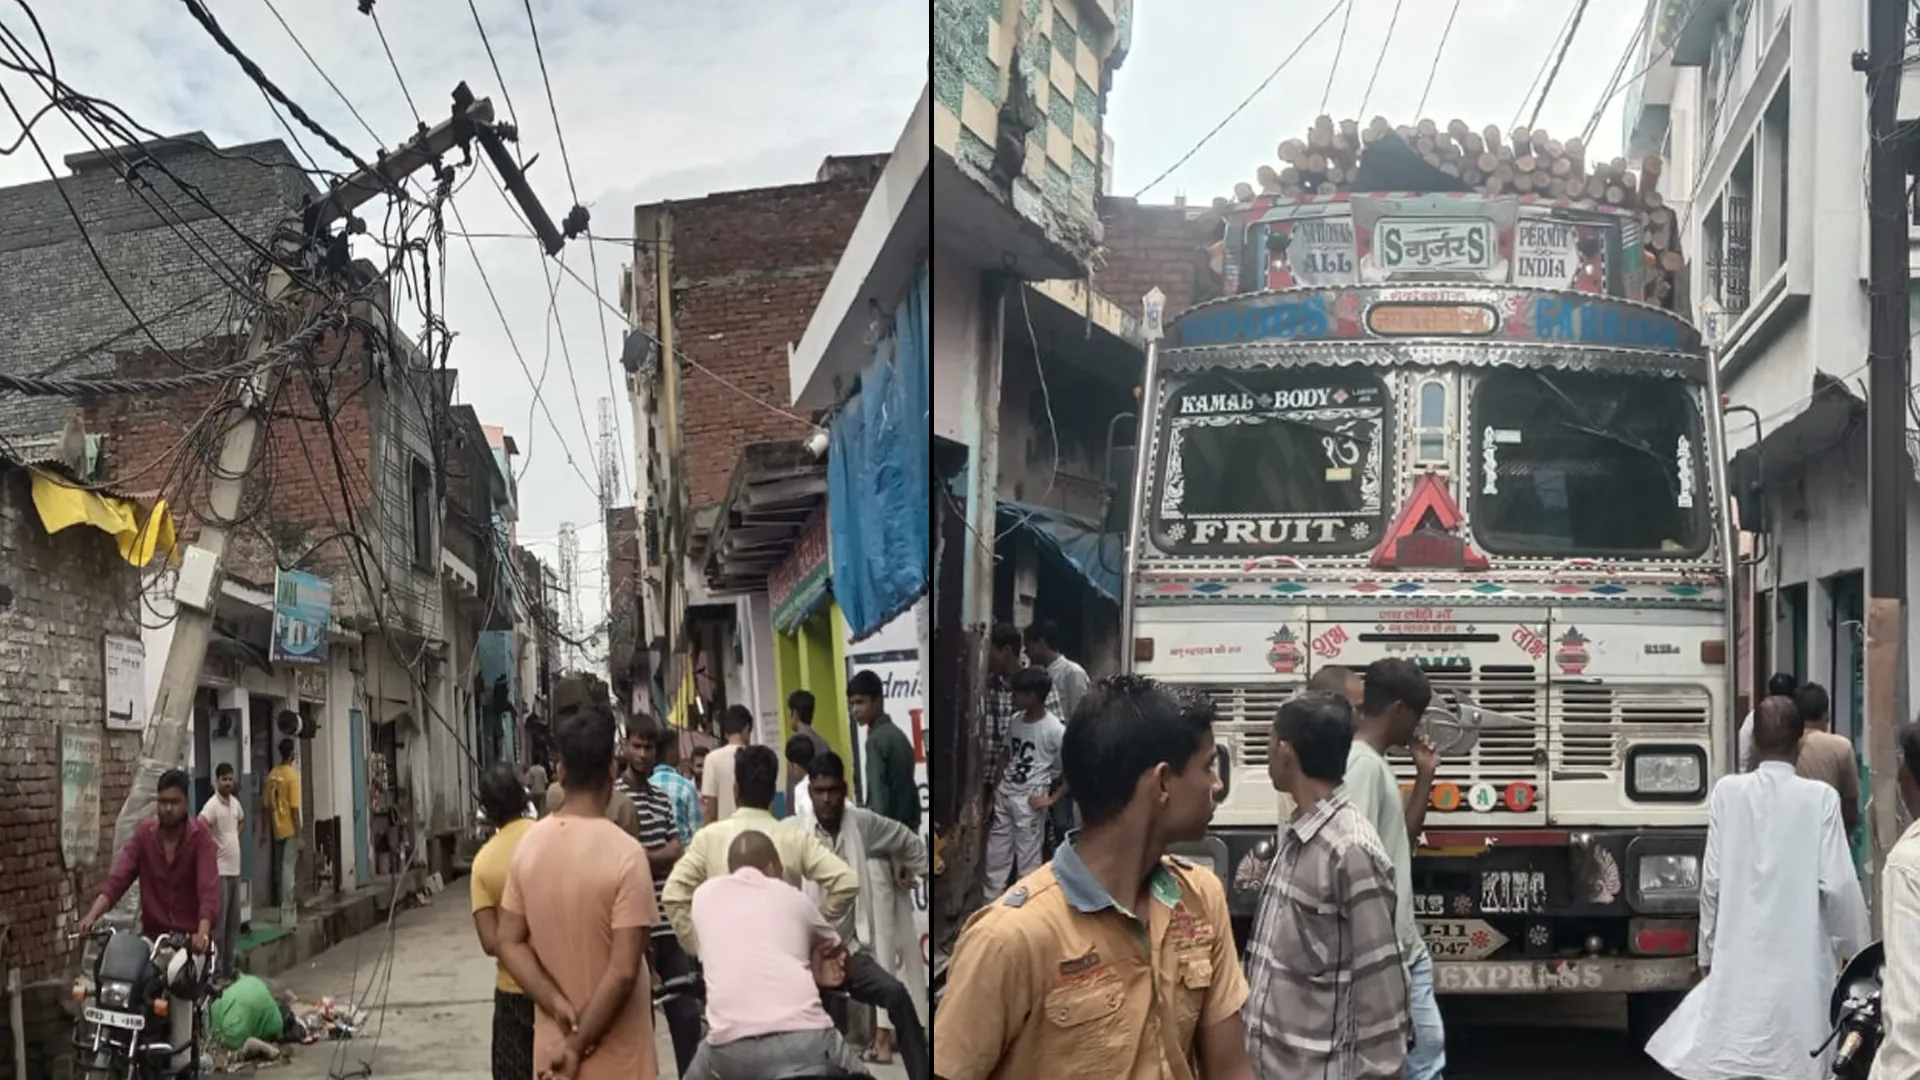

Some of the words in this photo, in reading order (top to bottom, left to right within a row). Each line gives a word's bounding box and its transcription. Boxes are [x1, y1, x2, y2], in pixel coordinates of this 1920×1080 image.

[1519, 225, 1569, 248] PERMIT
[1303, 252, 1353, 274] ALL
[1518, 256, 1567, 278] INDIA
[1273, 387, 1333, 409] BODY
[1190, 518, 1346, 545] FRUIT
[1311, 624, 1350, 659] शुभ
[882, 670, 924, 699] dmi
